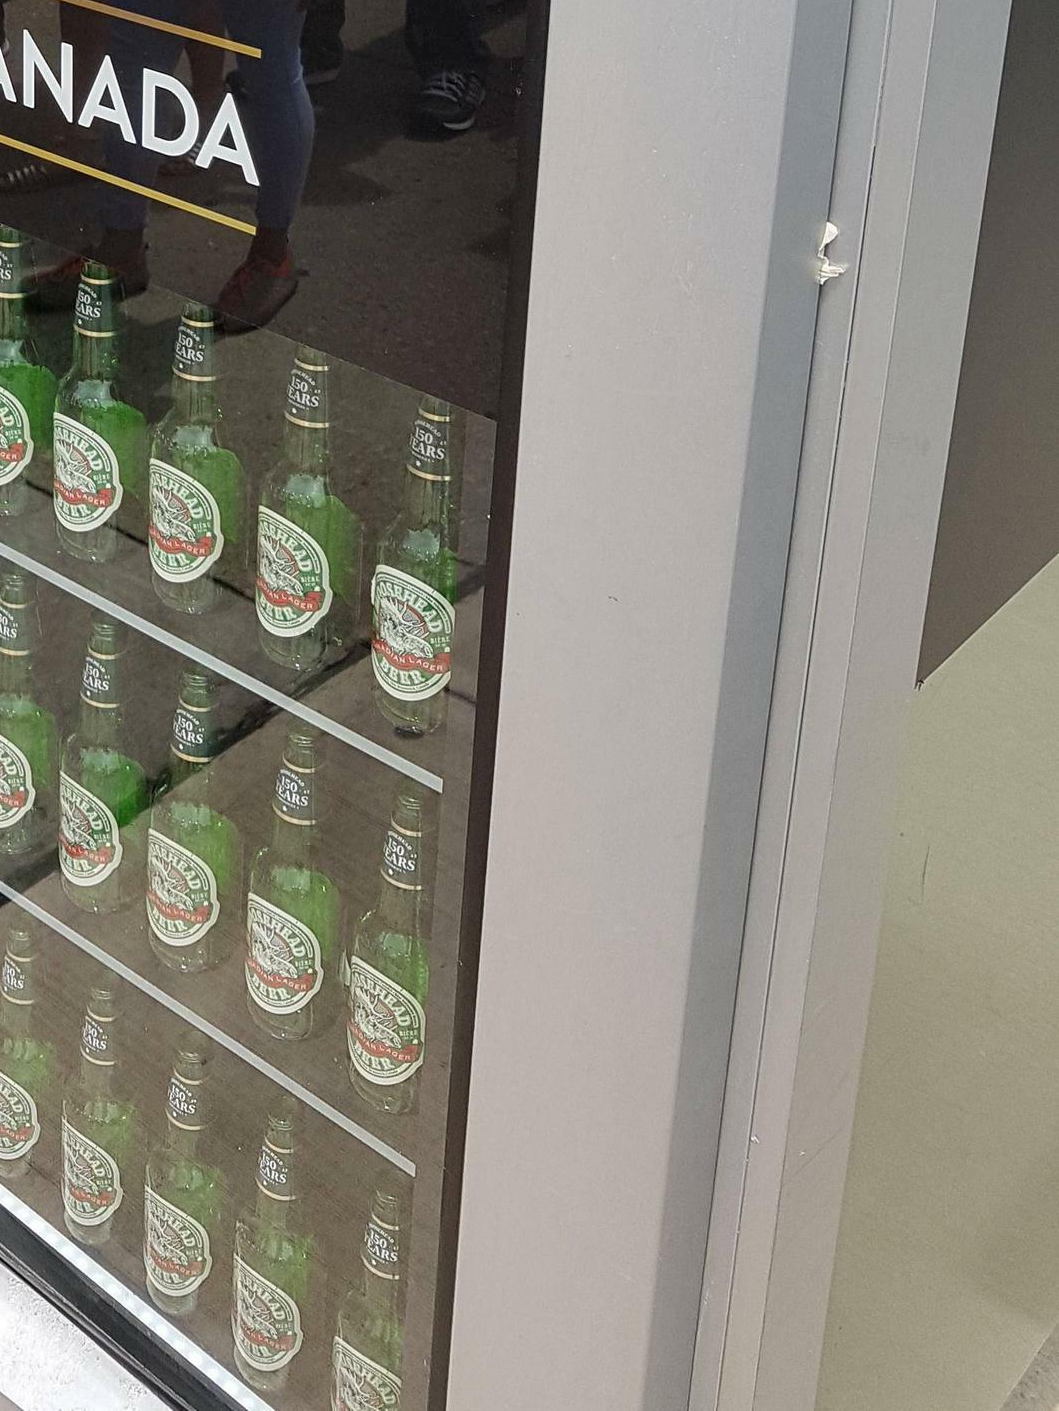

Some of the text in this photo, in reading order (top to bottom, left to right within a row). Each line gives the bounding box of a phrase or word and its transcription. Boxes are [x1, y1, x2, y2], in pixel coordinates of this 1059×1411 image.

[176, 341, 204, 362] EARS
[292, 376, 308, 392] 150
[415, 427, 433, 444] 150
[410, 434, 445, 459] EARS
[77, 493, 105, 505] LAGER
[175, 541, 206, 554] LAGER
[282, 594, 313, 609] LAGER
[382, 658, 425, 683] BEER
[408, 658, 443, 671] LAGER
[389, 839, 404, 855] 150
[274, 976, 307, 990] LAGER
[381, 1047, 411, 1061] LAGER
[259, 1159, 287, 1183] EARS
